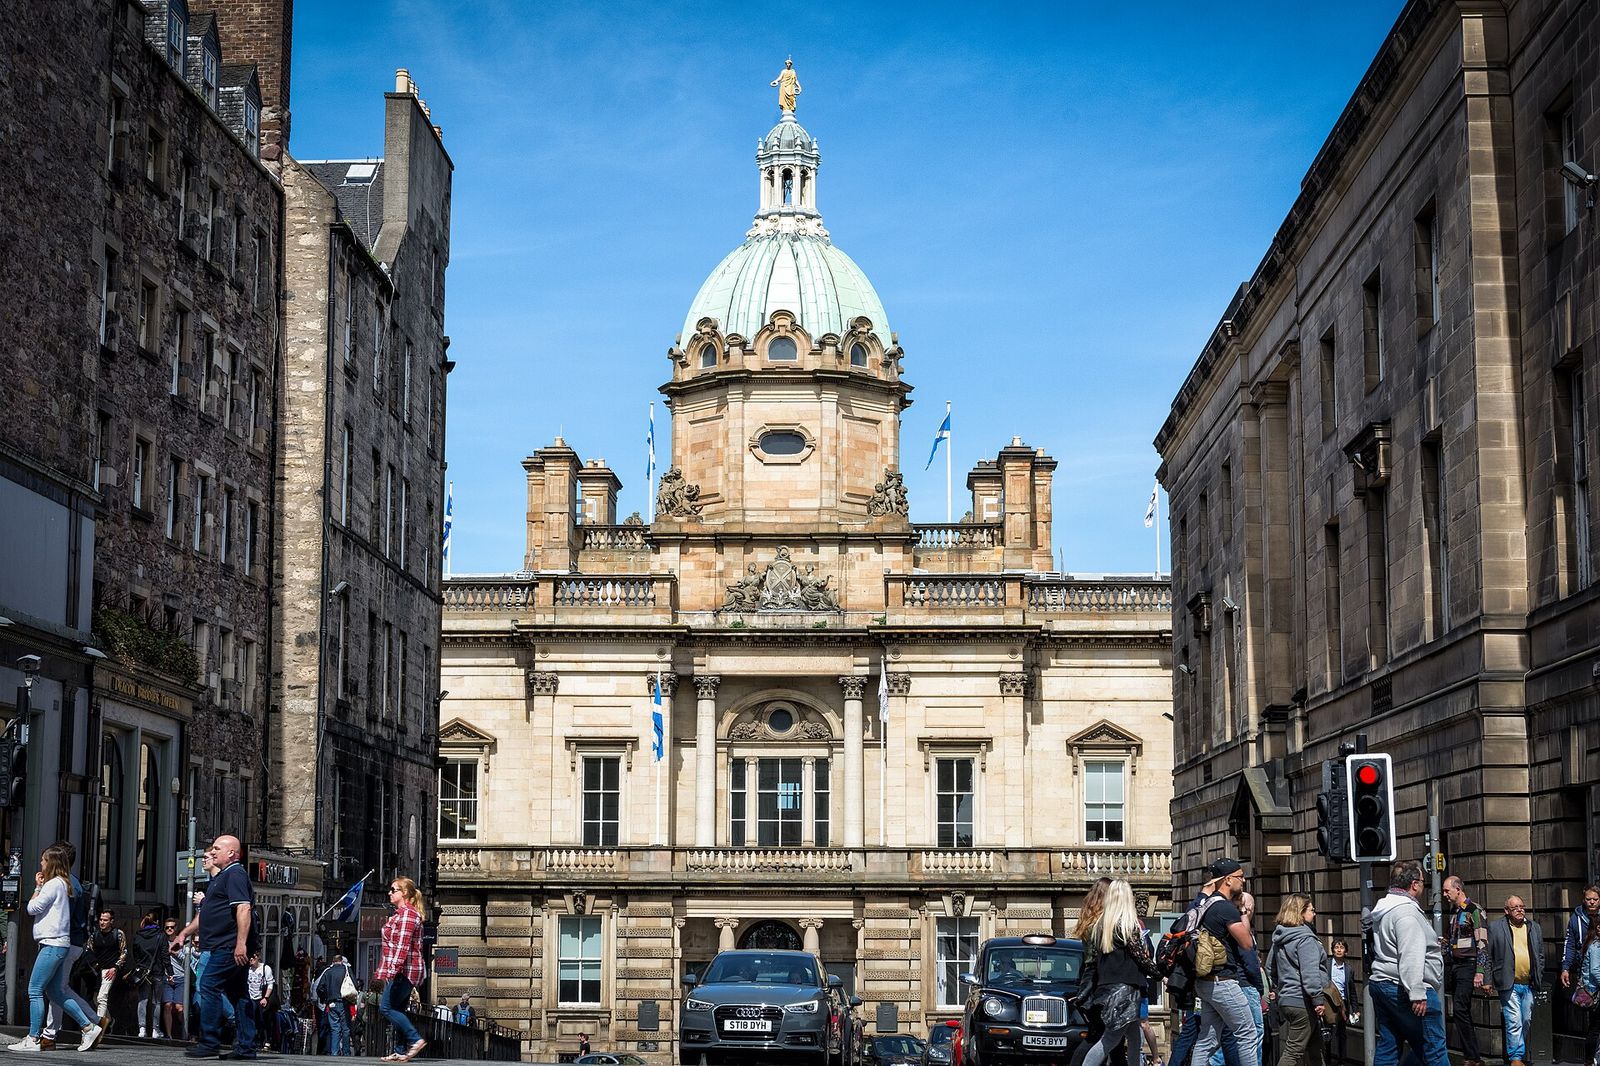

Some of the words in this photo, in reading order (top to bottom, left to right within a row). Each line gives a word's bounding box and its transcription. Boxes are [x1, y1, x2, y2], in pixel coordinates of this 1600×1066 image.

[730, 1020, 748, 1030] ST18
[750, 1021, 767, 1030] DYH
[1048, 1037, 1064, 1046] BYY
